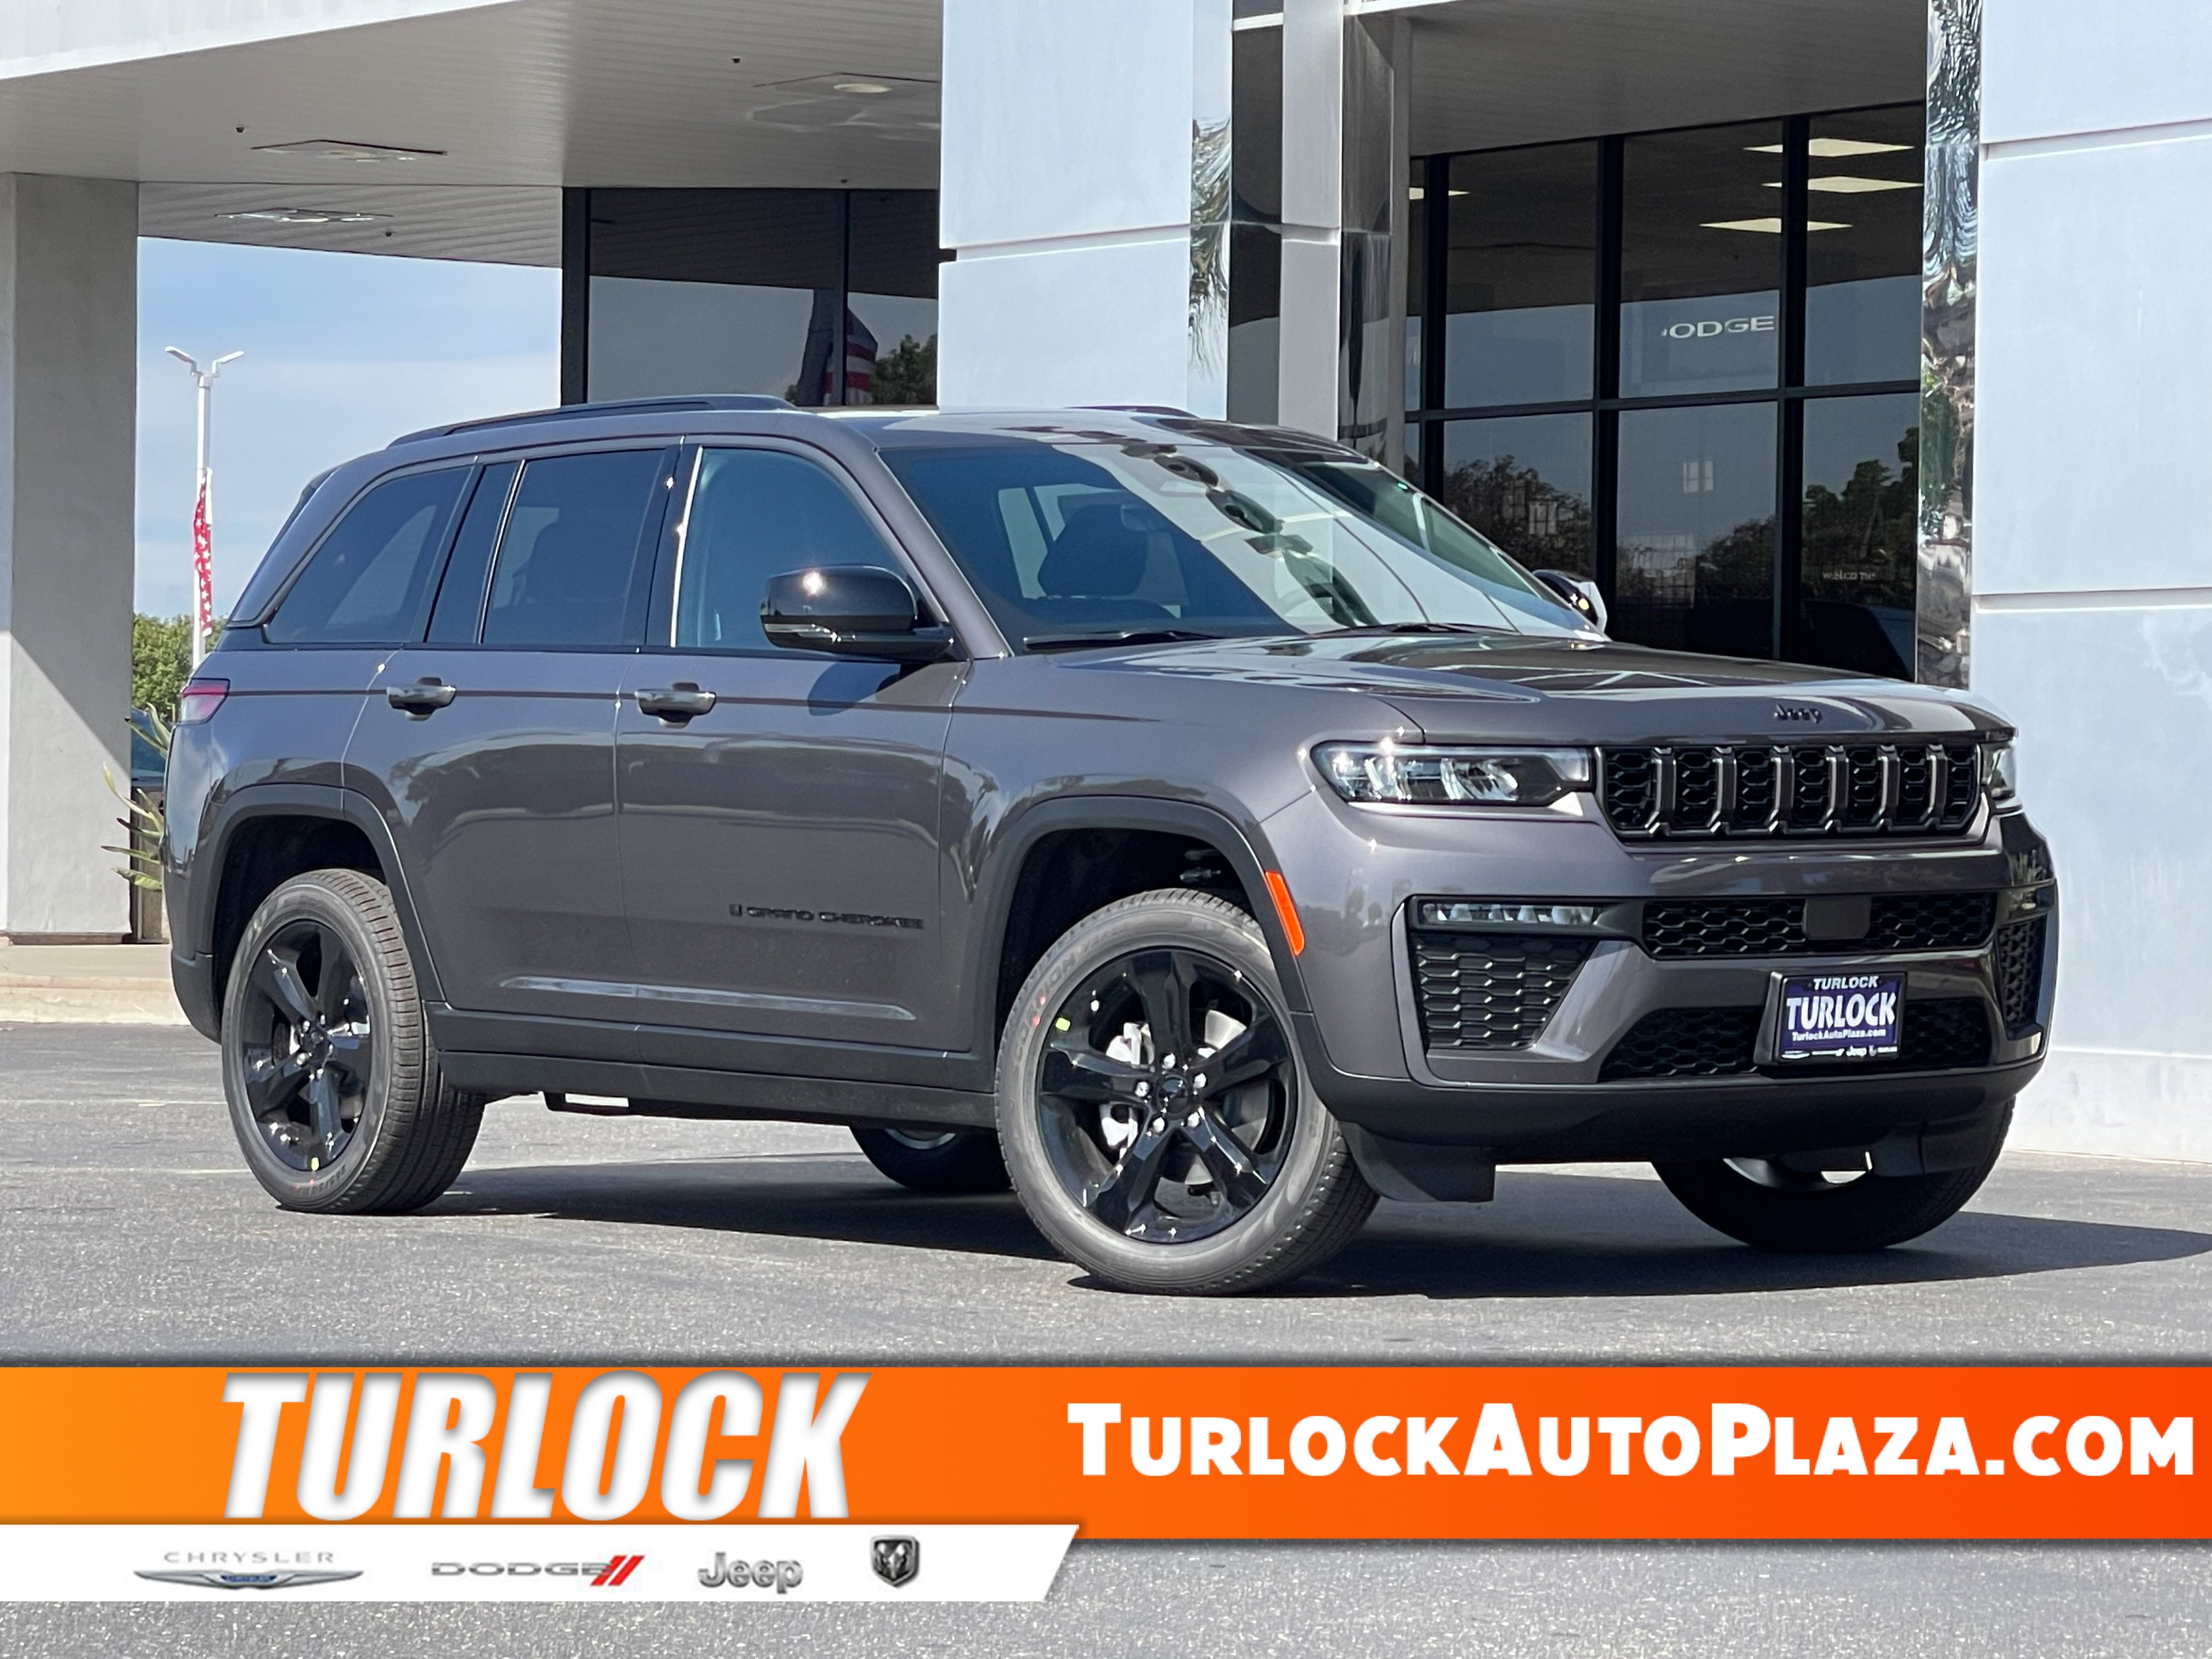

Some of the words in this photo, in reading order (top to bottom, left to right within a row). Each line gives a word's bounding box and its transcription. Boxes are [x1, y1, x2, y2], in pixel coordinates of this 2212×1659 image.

[1661, 315, 1775, 338] ODGE
[1813, 975, 1880, 991] TURLOCK
[1786, 992, 1897, 1030] TURLOCK
[1791, 1029, 1886, 1041] TurlockAutoPlaza.com
